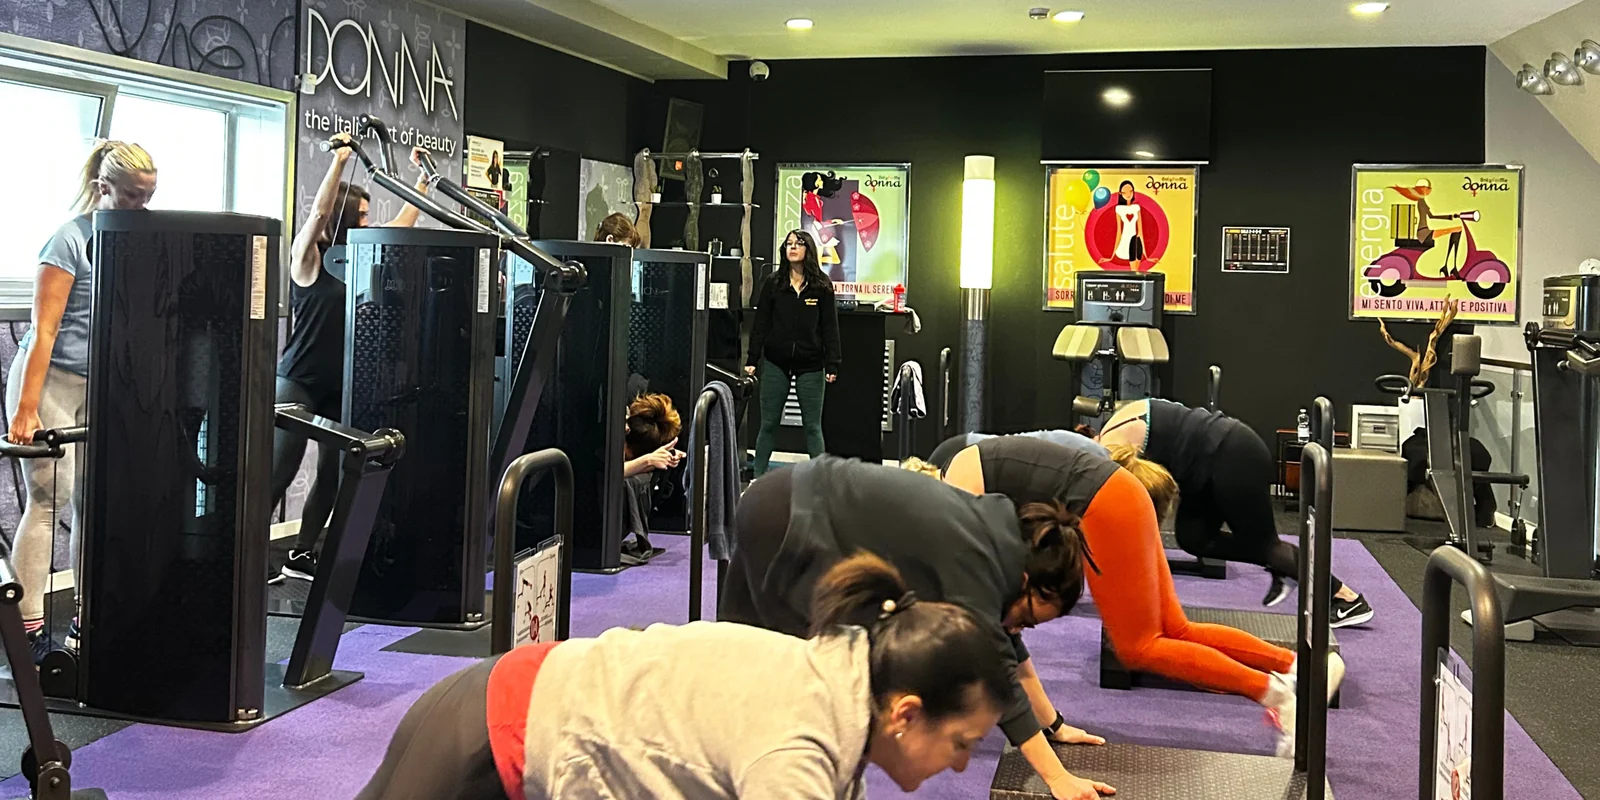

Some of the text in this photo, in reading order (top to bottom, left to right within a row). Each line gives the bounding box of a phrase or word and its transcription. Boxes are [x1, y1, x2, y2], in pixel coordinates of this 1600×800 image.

[306, 8, 458, 121] DONNA
[305, 109, 330, 131] the
[334, 113, 376, 140] Italin
[400, 127, 413, 146] of
[416, 128, 457, 157] beauty
[864, 174, 902, 190] donna
[1145, 175, 1188, 192] donna
[1462, 176, 1510, 194] donna
[784, 175, 802, 232] ezza
[1048, 203, 1075, 289] salute
[1360, 188, 1389, 298] energia
[842, 284, 863, 293] TORNA
[864, 285, 871, 294] IL
[872, 285, 895, 294] SEREN
[1055, 290, 1074, 300] SORR
[1175, 294, 1186, 304] ME
[1362, 299, 1507, 312] MI SENTO VIVA, ATTV E POSITIVA
